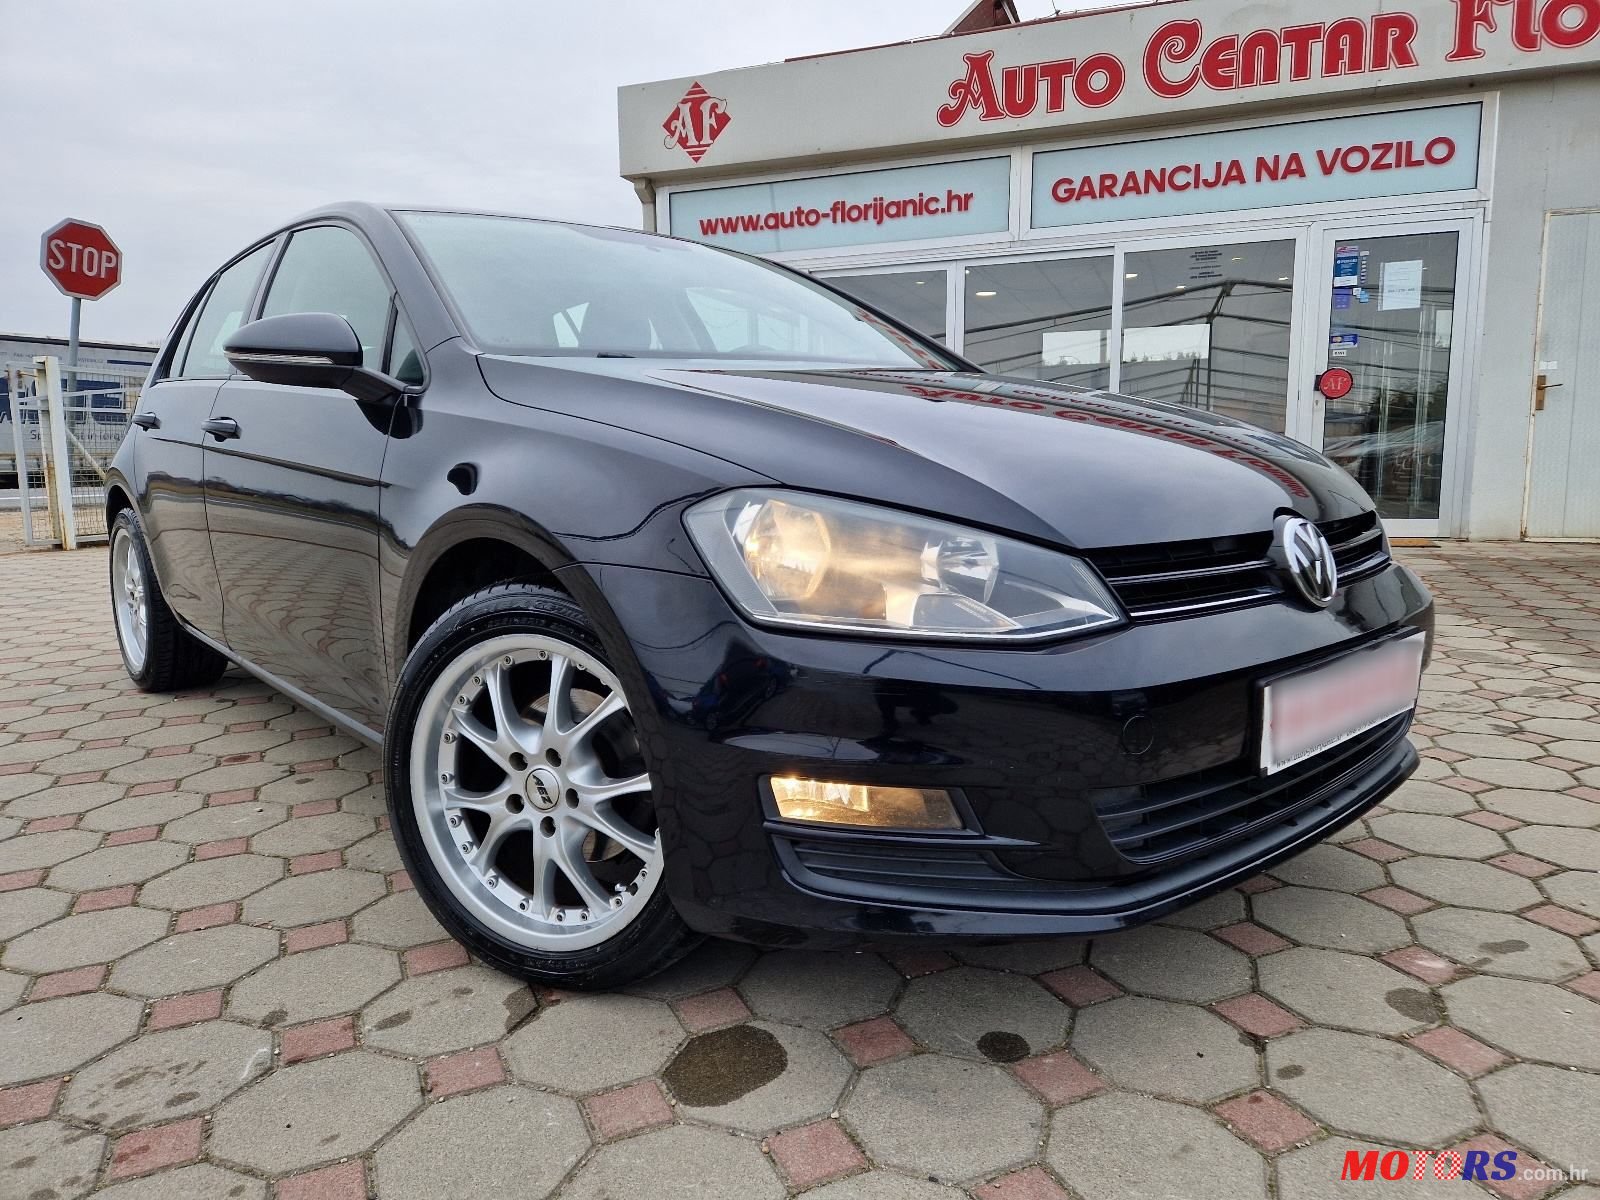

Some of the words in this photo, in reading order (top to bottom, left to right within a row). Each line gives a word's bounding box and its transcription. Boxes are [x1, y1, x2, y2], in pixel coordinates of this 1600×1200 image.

[937, 49, 1126, 127] AUTO
[1143, 11, 1419, 98] CENTAR
[1052, 159, 1246, 204] GARANCIJA
[1255, 152, 1306, 183] NA
[1316, 136, 1456, 176] VOZILO
[700, 189, 974, 236] www.auto-florijanic.hr
[48, 239, 117, 279] STOP
